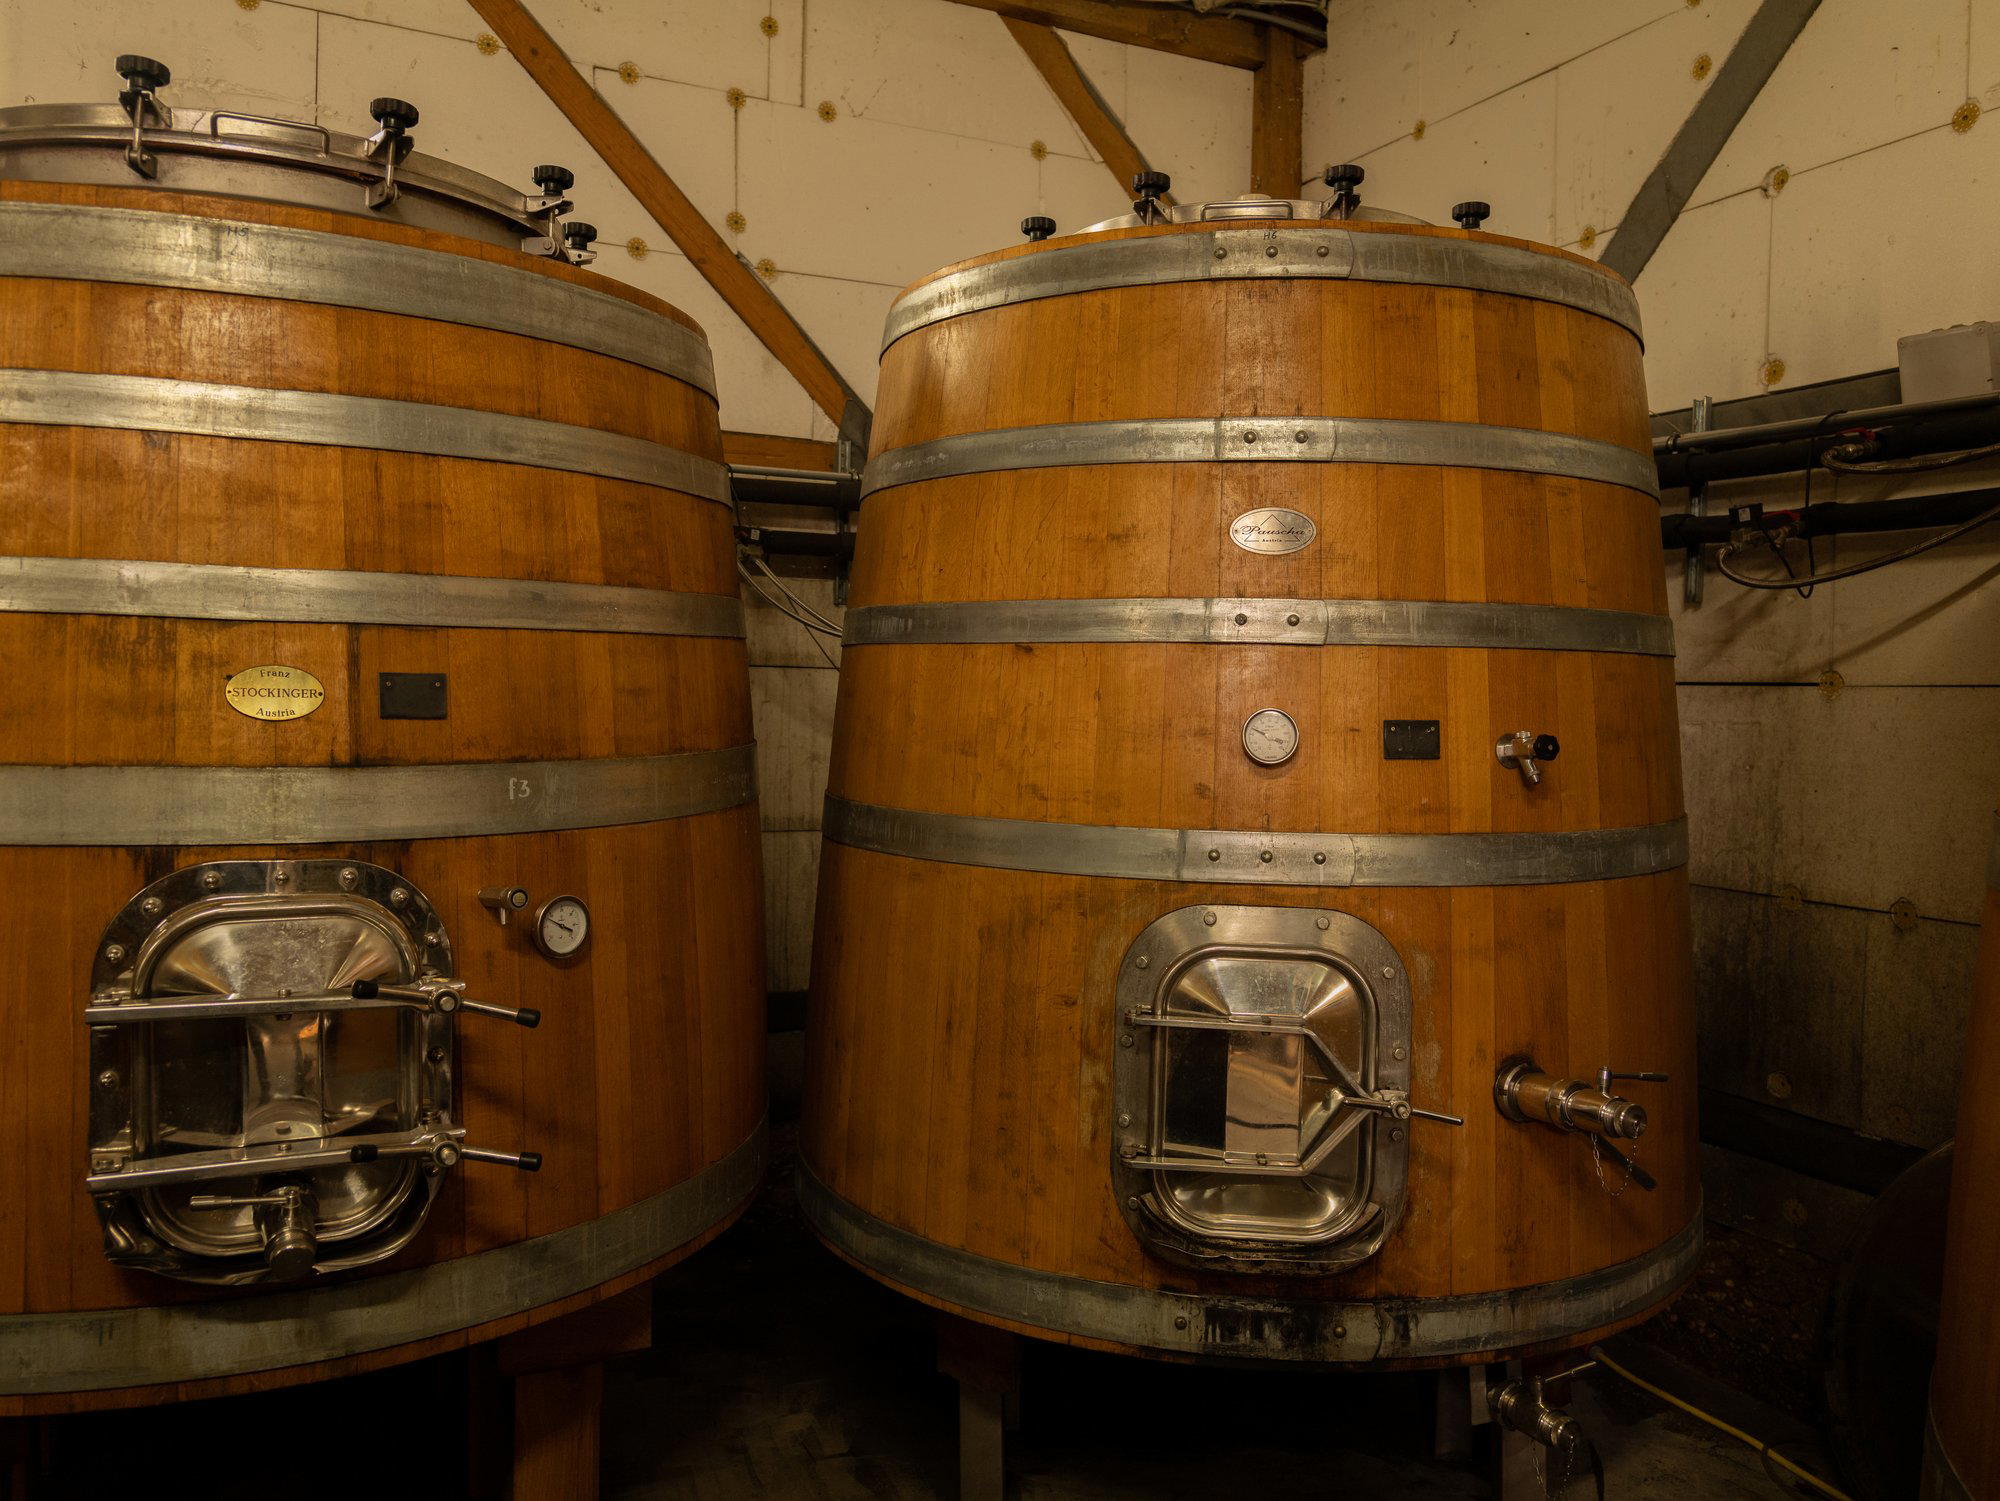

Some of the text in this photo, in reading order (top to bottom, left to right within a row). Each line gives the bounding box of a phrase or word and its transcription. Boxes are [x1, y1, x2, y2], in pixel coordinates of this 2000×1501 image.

[1263, 230, 1278, 240] H6
[1240, 525, 1305, 536] Pauscha
[260, 669, 291, 679] Franz
[232, 687, 319, 699] STOCKINGER
[256, 707, 296, 718] Austria
